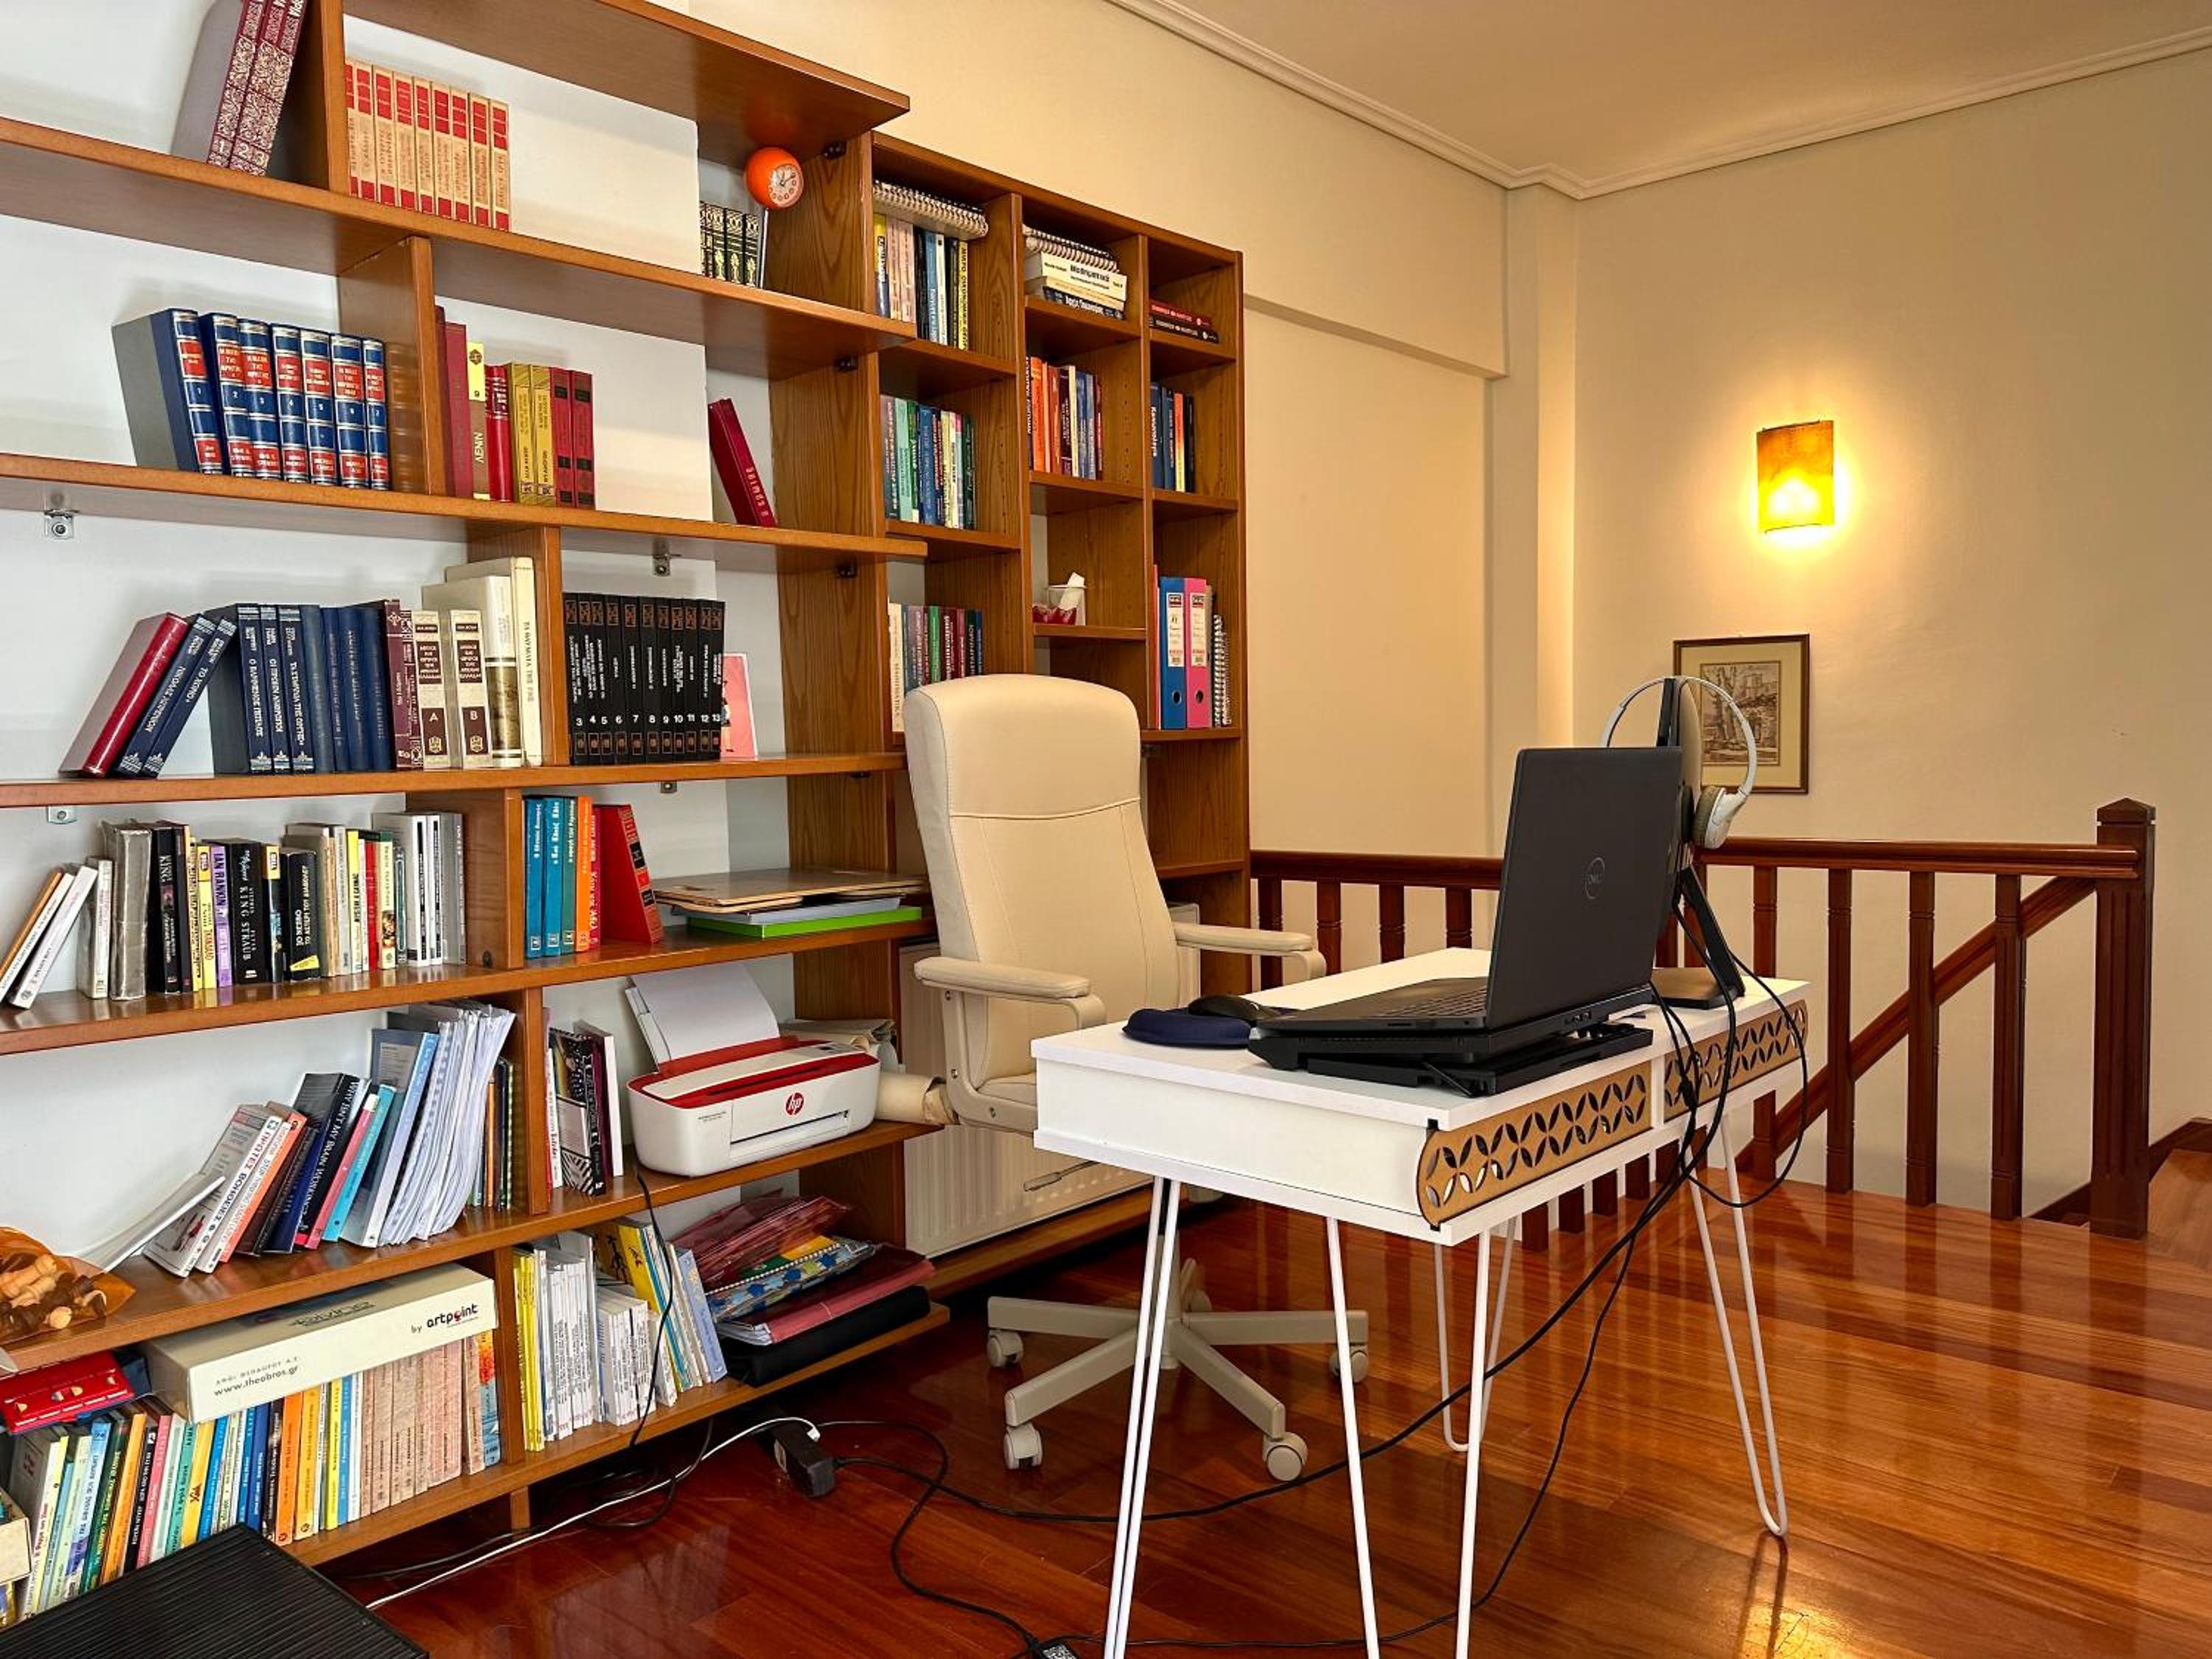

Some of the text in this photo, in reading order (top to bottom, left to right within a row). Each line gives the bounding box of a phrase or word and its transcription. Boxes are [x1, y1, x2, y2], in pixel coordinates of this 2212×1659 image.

[219, 141, 224, 153] 1
[238, 142, 248, 159] 2
[254, 151, 269, 168] 3
[576, 718, 582, 726] 3
[590, 715, 596, 723] 4
[601, 717, 608, 725] 5
[616, 715, 622, 723] 6
[633, 714, 639, 723] 7
[649, 714, 655, 723] 8
[663, 715, 669, 723] 9
[675, 714, 684, 723] 10
[687, 714, 695, 722] 11
[701, 714, 709, 723] 12
[712, 714, 720, 722] 13
[159, 855, 167, 883] KING
[214, 853, 226, 907] IAN RANKIN
[240, 886, 251, 961] KING STRAUB
[344, 1082, 358, 1102] WHY
[787, 1092, 803, 1116] hp
[336, 1102, 350, 1124] ISN'T
[330, 1125, 341, 1140] MY
[318, 1141, 335, 1166] BRAIN
[411, 1303, 479, 1334] by artpoint
